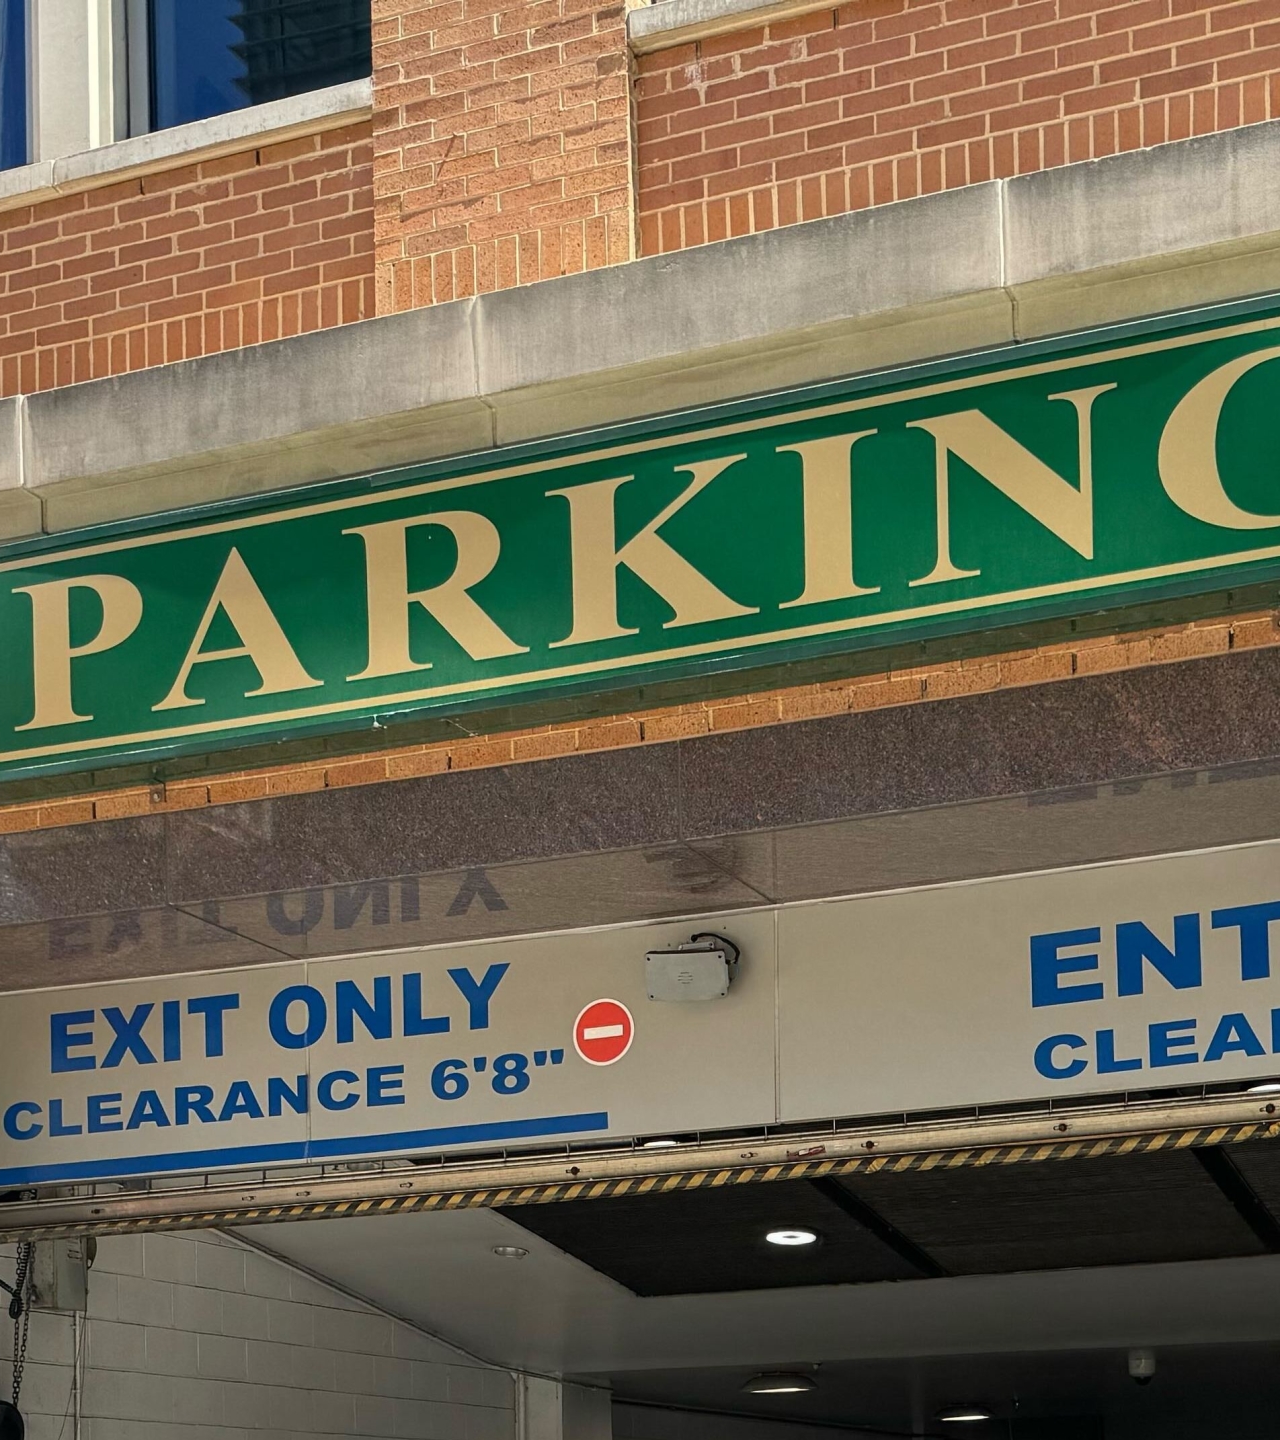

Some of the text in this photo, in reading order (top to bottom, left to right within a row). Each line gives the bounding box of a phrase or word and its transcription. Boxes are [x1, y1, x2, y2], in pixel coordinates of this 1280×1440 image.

[49, 962, 510, 1075] EXIT ONLY
[3, 1048, 565, 1141] CLEARANCE 6'8"
